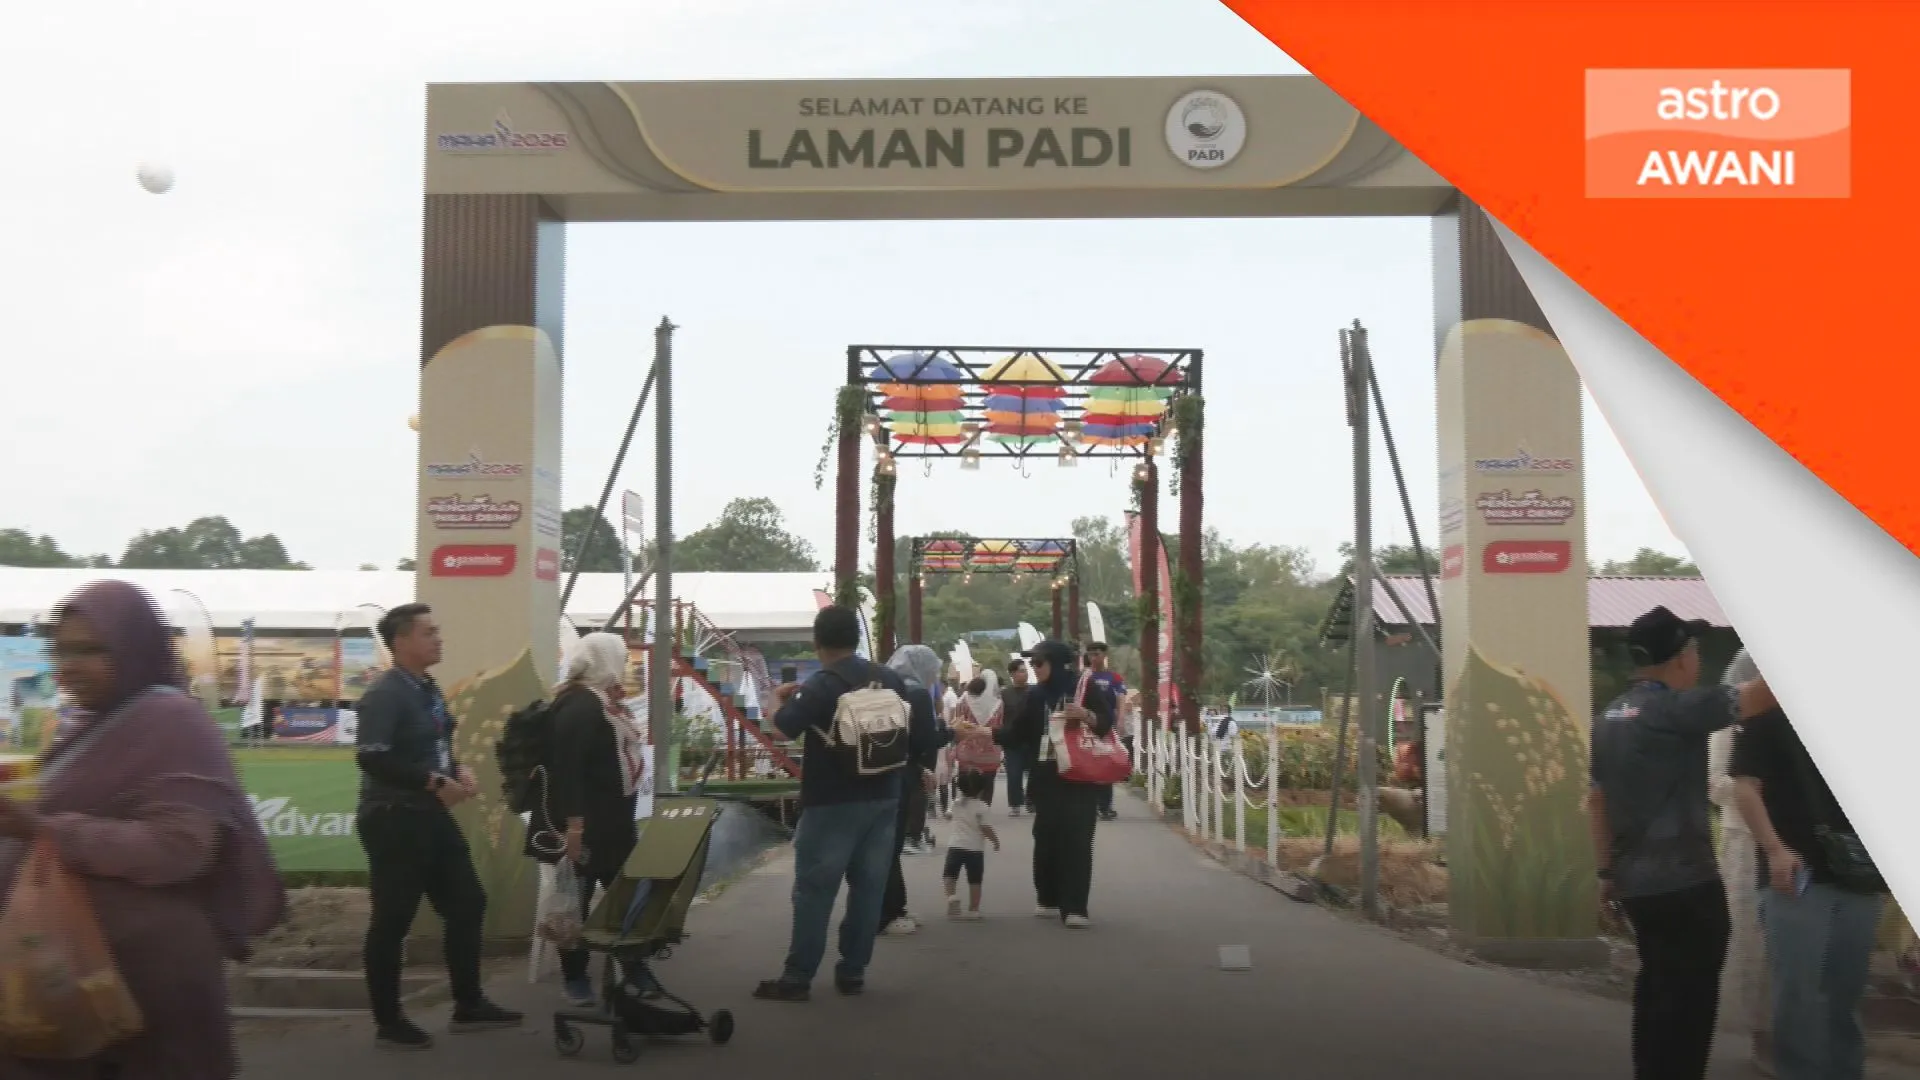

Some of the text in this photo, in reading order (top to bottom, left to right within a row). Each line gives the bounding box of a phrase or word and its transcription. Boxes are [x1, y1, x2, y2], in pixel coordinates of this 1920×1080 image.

[798, 96, 1088, 116] SELAMAT DATANG KE
[511, 133, 567, 147] 2026
[747, 127, 1131, 169] LAMAN PADI
[1187, 149, 1224, 161] PADI
[481, 463, 523, 475] 2026
[1530, 458, 1574, 470] 2026
